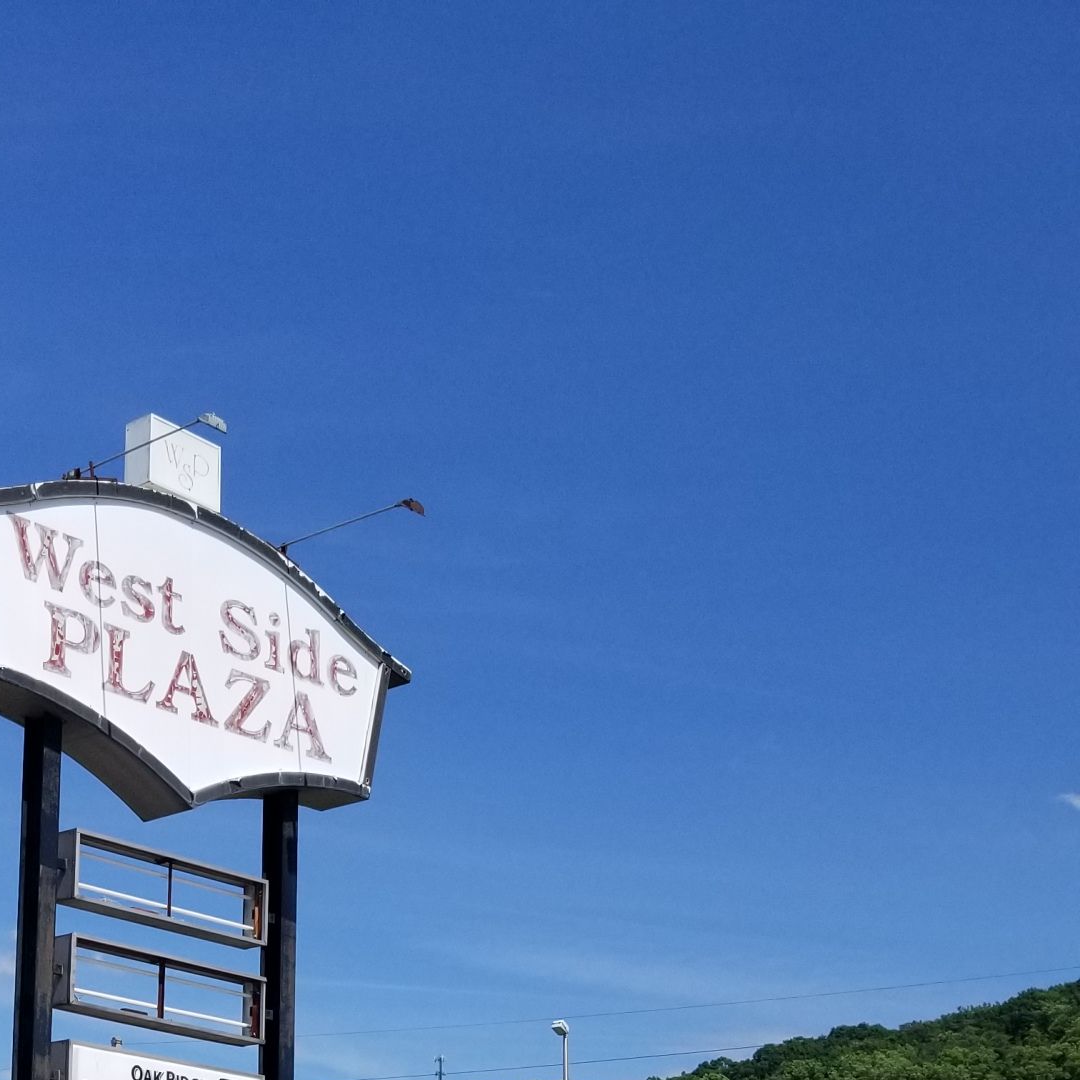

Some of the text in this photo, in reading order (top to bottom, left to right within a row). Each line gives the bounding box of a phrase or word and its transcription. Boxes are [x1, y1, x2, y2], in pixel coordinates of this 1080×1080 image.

[6, 511, 358, 697] West Side
[42, 600, 332, 763] PLAZA
